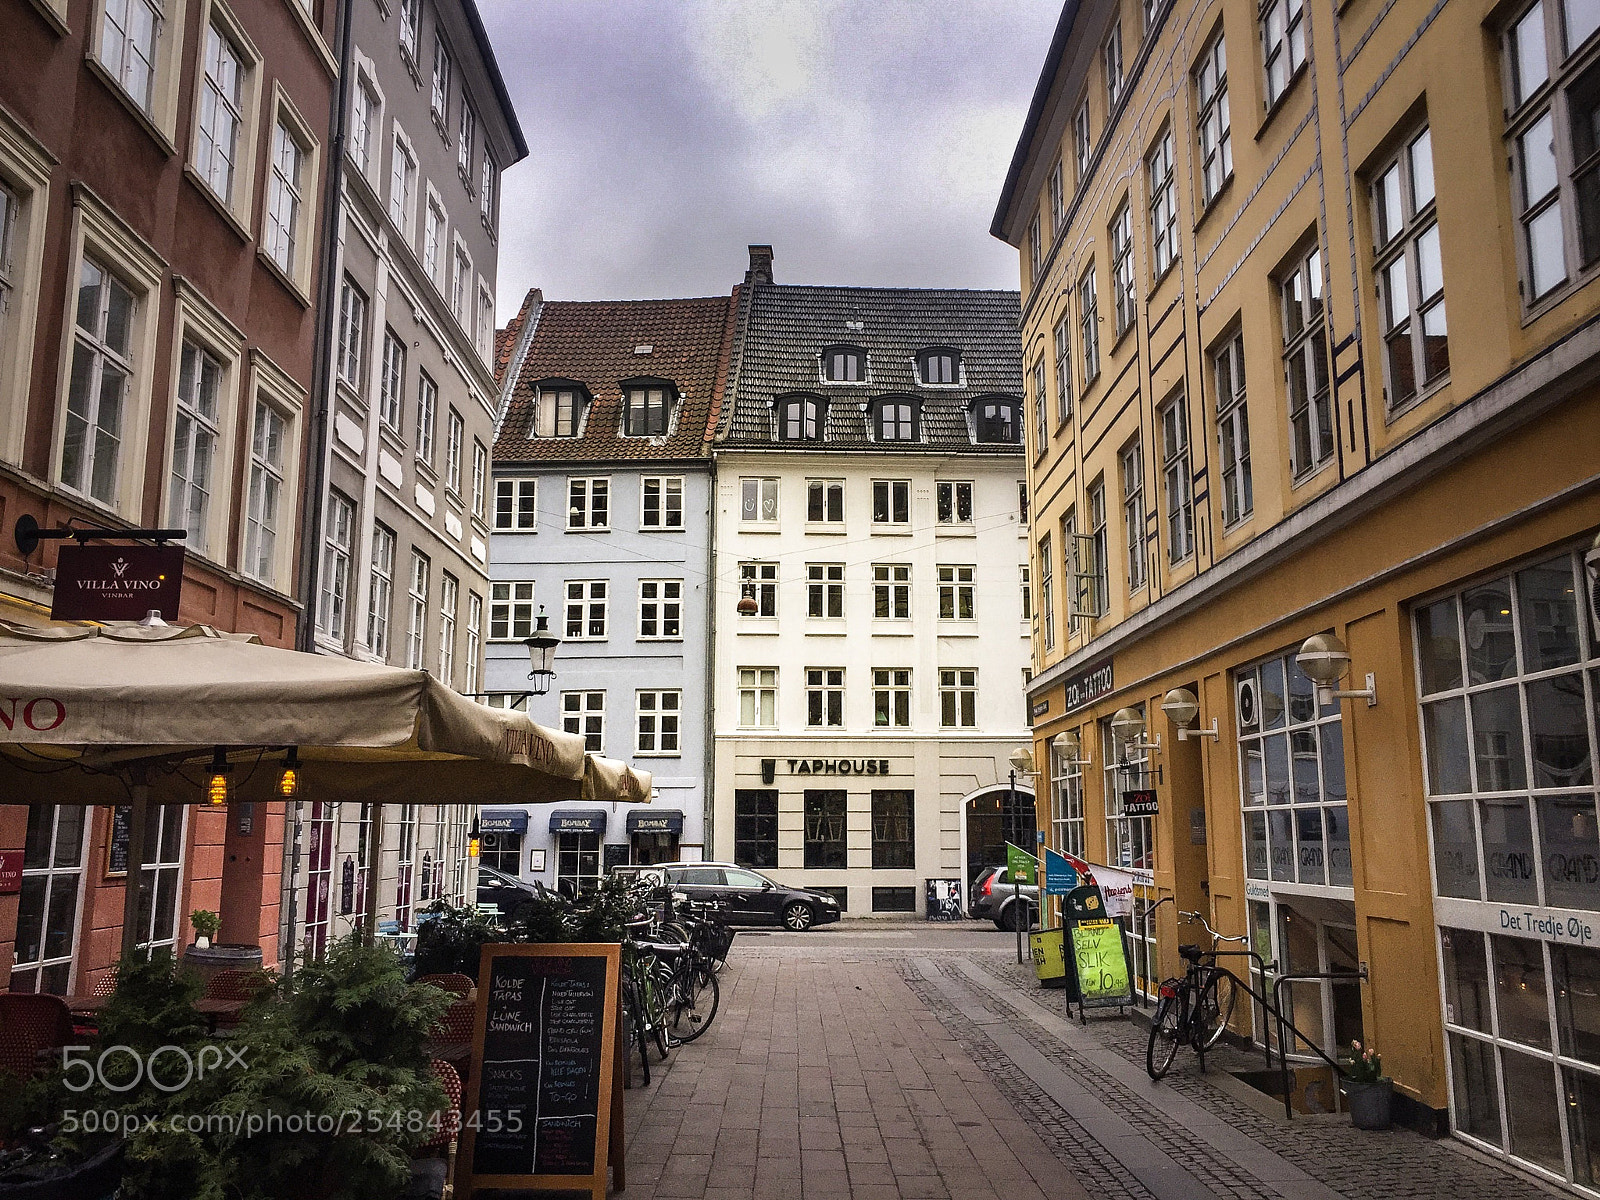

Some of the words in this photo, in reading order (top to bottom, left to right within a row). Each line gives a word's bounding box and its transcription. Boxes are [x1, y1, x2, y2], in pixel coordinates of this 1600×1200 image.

[77, 580, 119, 590] VILLA
[123, 580, 161, 590] VINO
[787, 759, 889, 774] TAPHOUSE
[1124, 801, 1159, 813] TATTOO
[482, 819, 512, 828] BOMBAY
[561, 819, 591, 828] BOMBAY
[638, 819, 668, 828] BOMBAY
[1500, 910, 1522, 931] Det
[1523, 912, 1563, 940] Tredje
[1567, 917, 1592, 944] Øje
[1075, 938, 1101, 950] SELV
[1078, 951, 1110, 968] SLIK
[495, 975, 526, 989] KOLDE
[493, 989, 522, 1001] TAPAS
